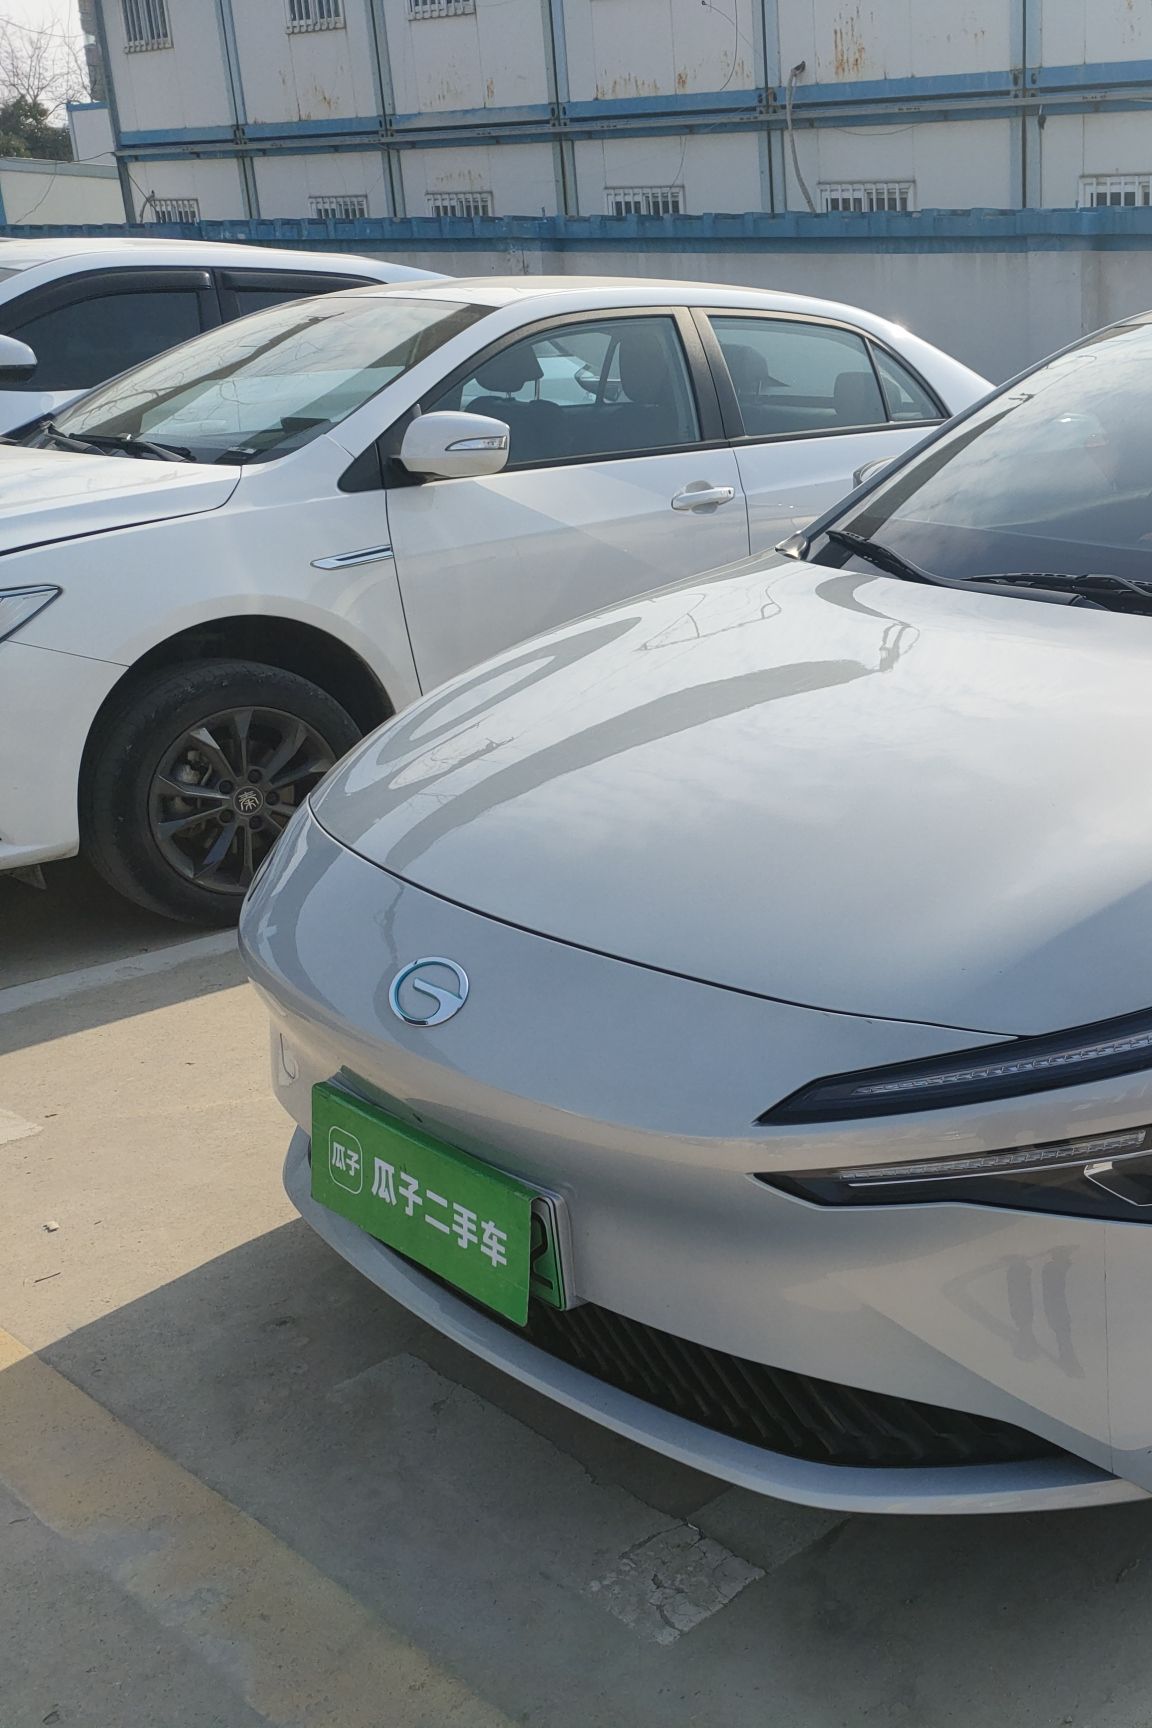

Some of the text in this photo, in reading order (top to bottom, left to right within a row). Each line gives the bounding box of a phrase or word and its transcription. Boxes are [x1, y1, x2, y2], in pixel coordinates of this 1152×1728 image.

[331, 1141, 360, 1176] 瓜子
[371, 1157, 507, 1268] 瓜子二手车
